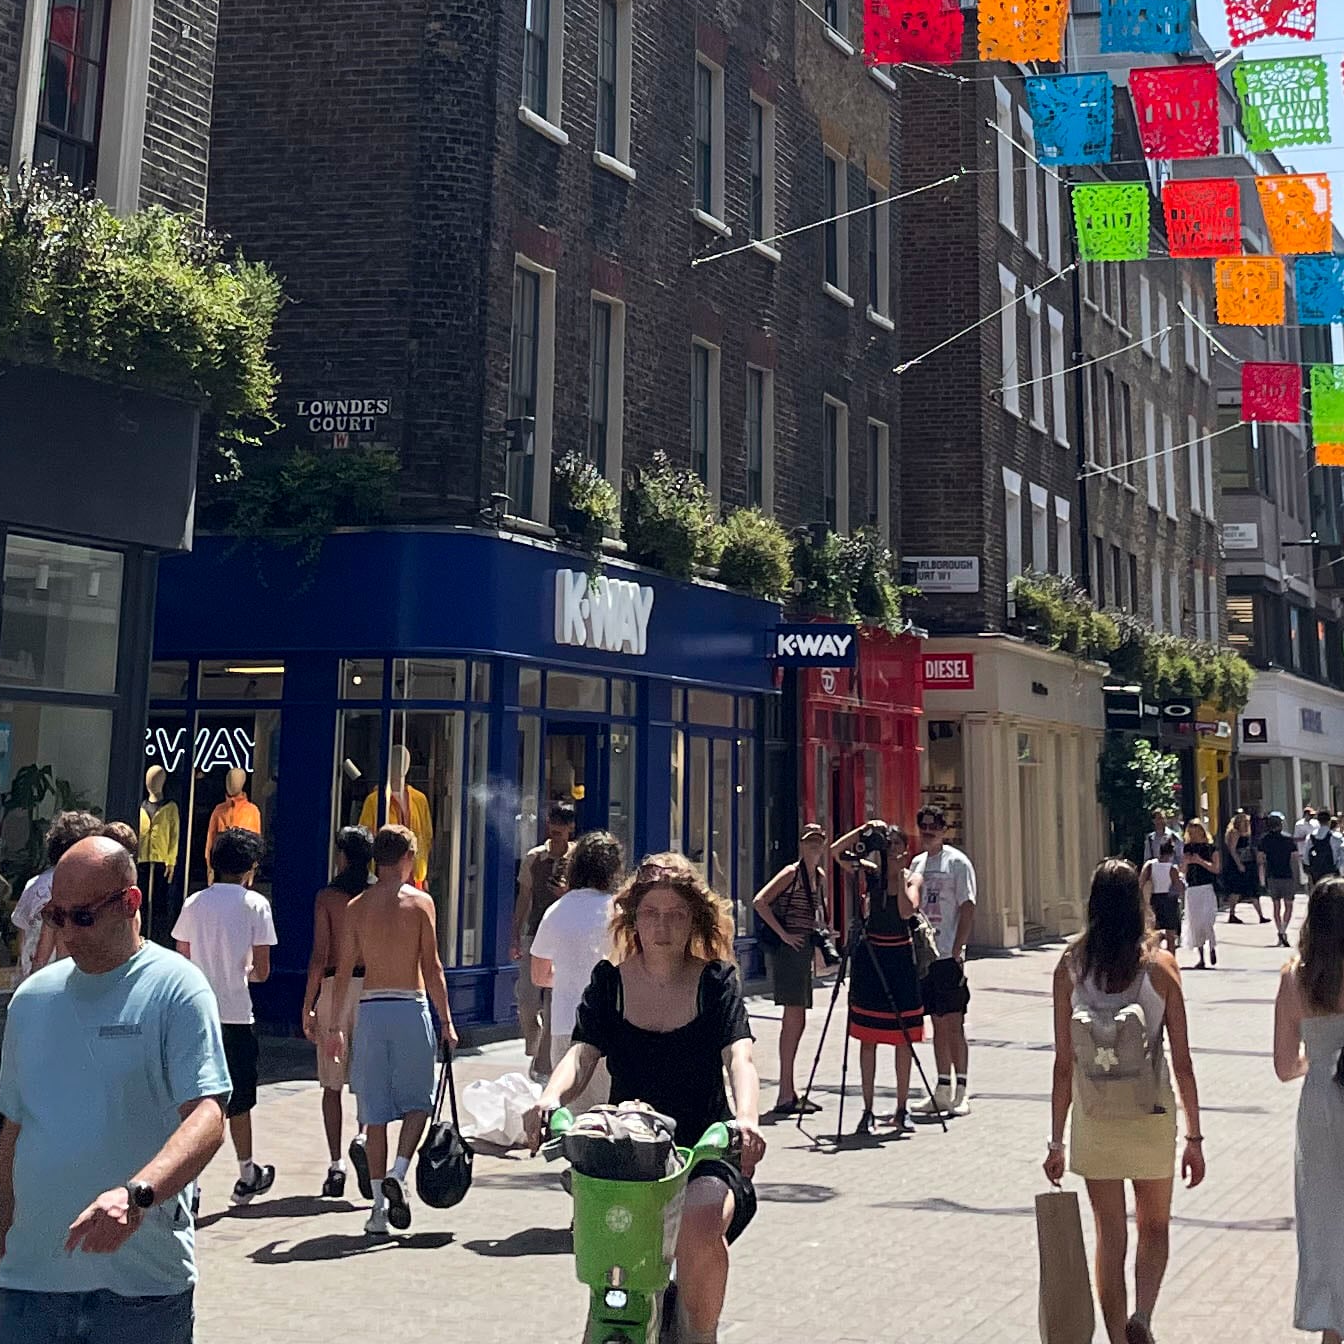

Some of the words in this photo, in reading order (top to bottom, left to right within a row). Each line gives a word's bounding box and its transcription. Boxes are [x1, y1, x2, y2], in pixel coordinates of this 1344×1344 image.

[1277, 99, 1320, 120] OWN
[297, 399, 389, 416] LOWNDES
[309, 416, 374, 432] COURT
[925, 660, 970, 679] DIESEL
